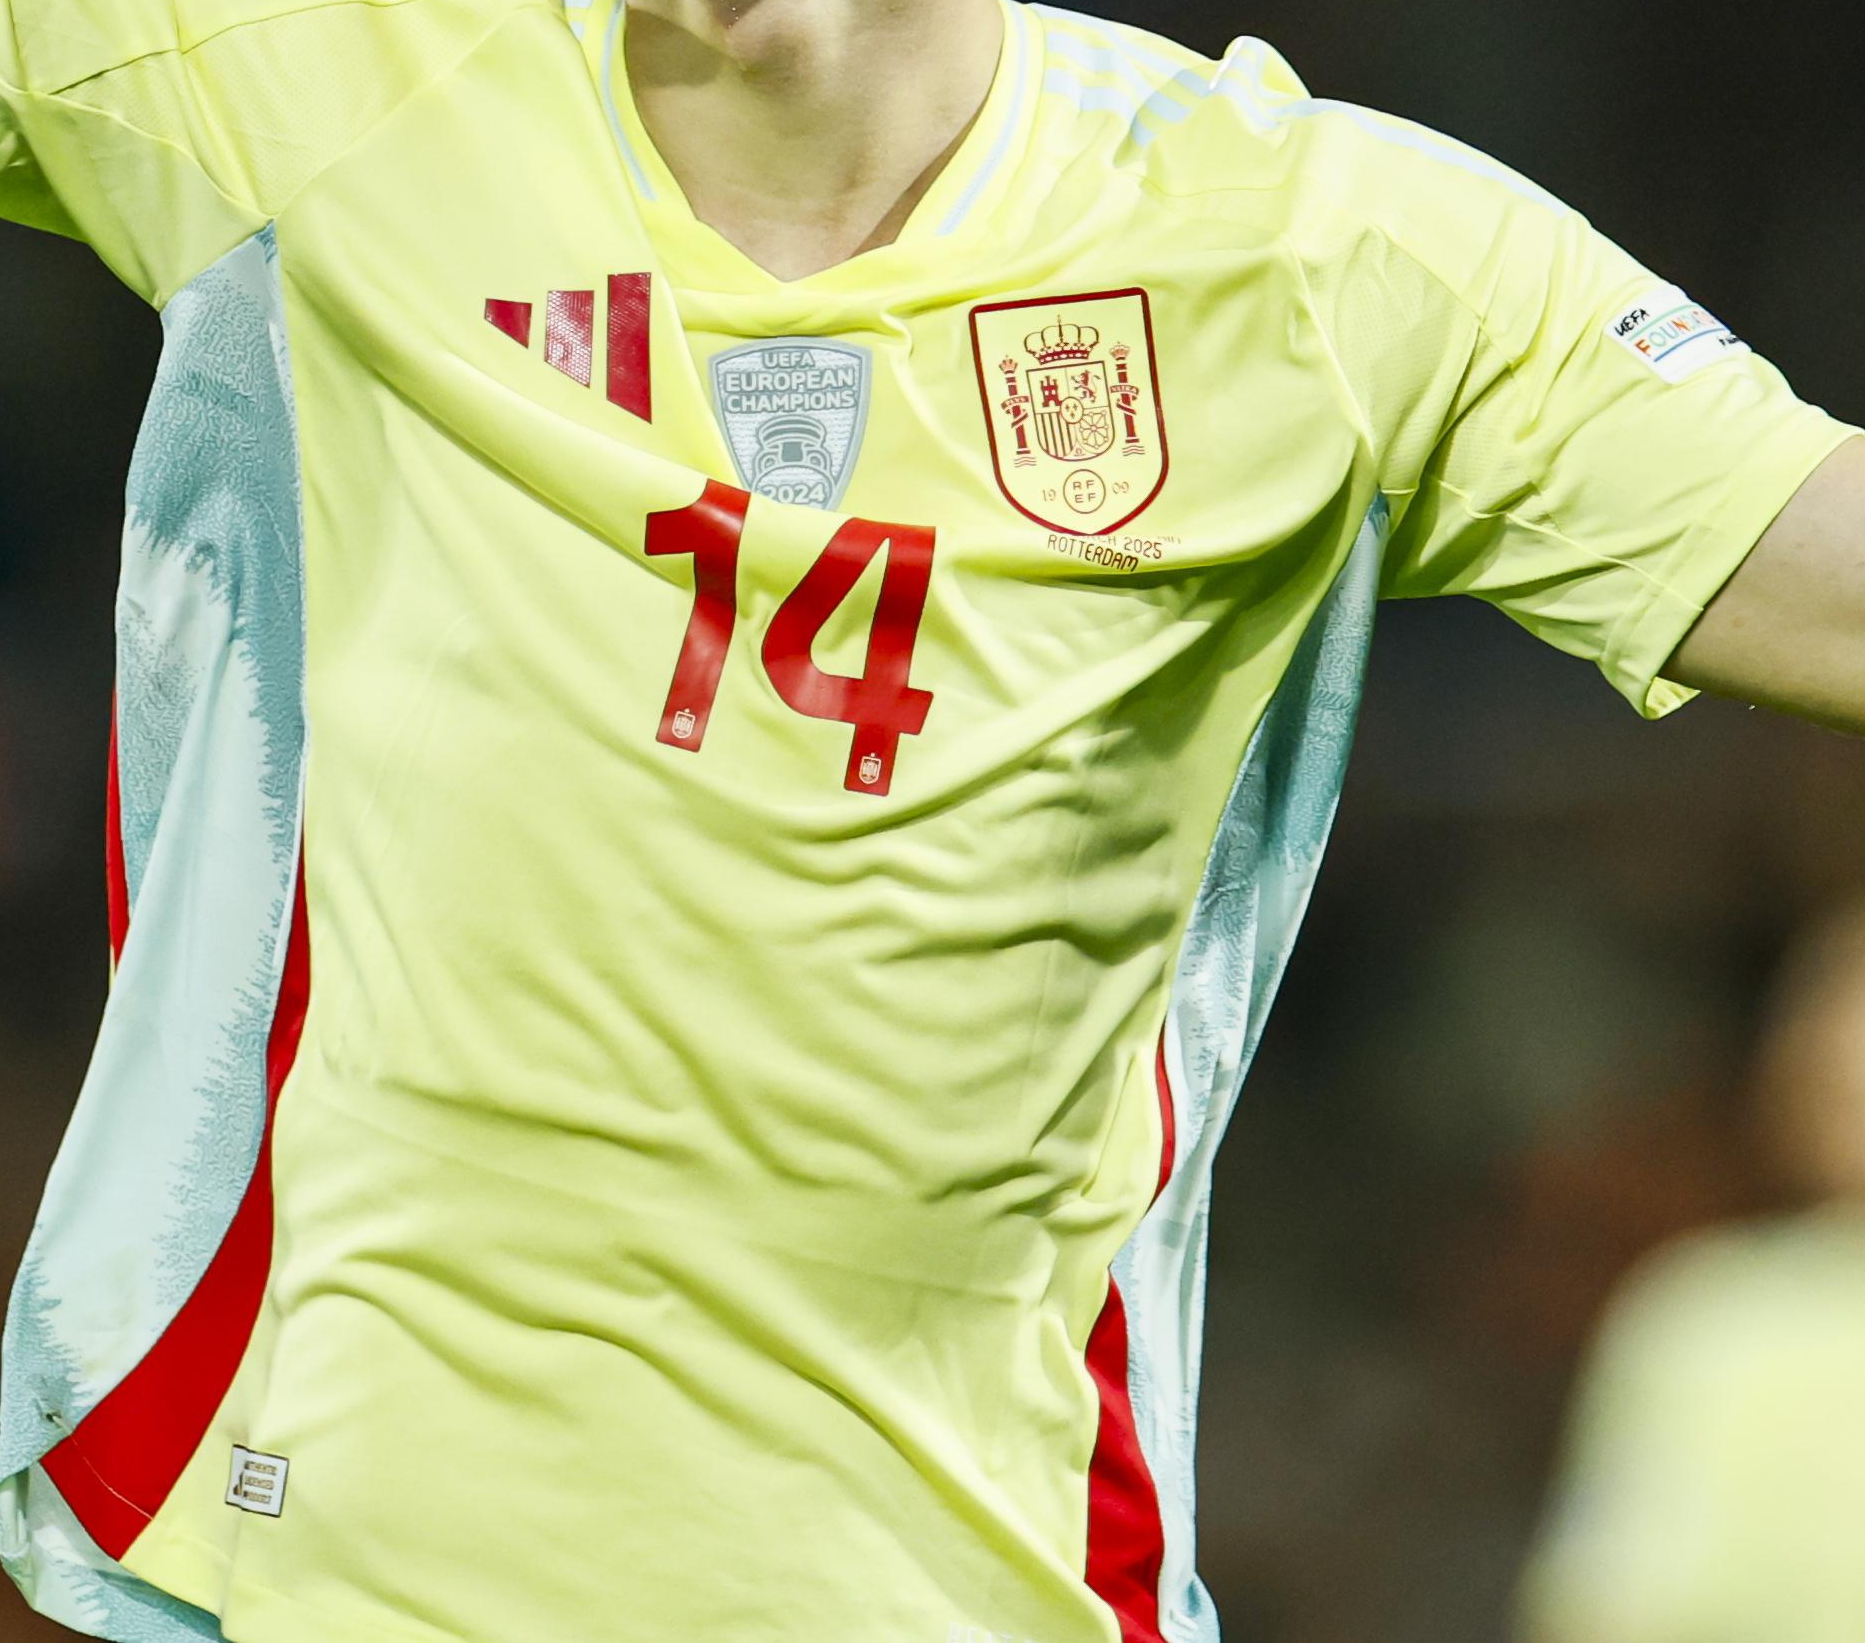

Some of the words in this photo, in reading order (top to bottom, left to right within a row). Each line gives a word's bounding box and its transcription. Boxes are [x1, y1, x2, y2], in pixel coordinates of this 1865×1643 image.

[1614, 309, 1650, 336] UEFA
[764, 351, 814, 367] UEFA
[726, 369, 854, 392] EUROPEAN
[727, 390, 855, 412] CHAMPIONS
[763, 483, 825, 503] 2024
[1042, 488, 1056, 501] 19
[1047, 534, 1139, 572] ROTTERDAM
[1123, 536, 1162, 559] 2025
[645, 478, 936, 796] 14
